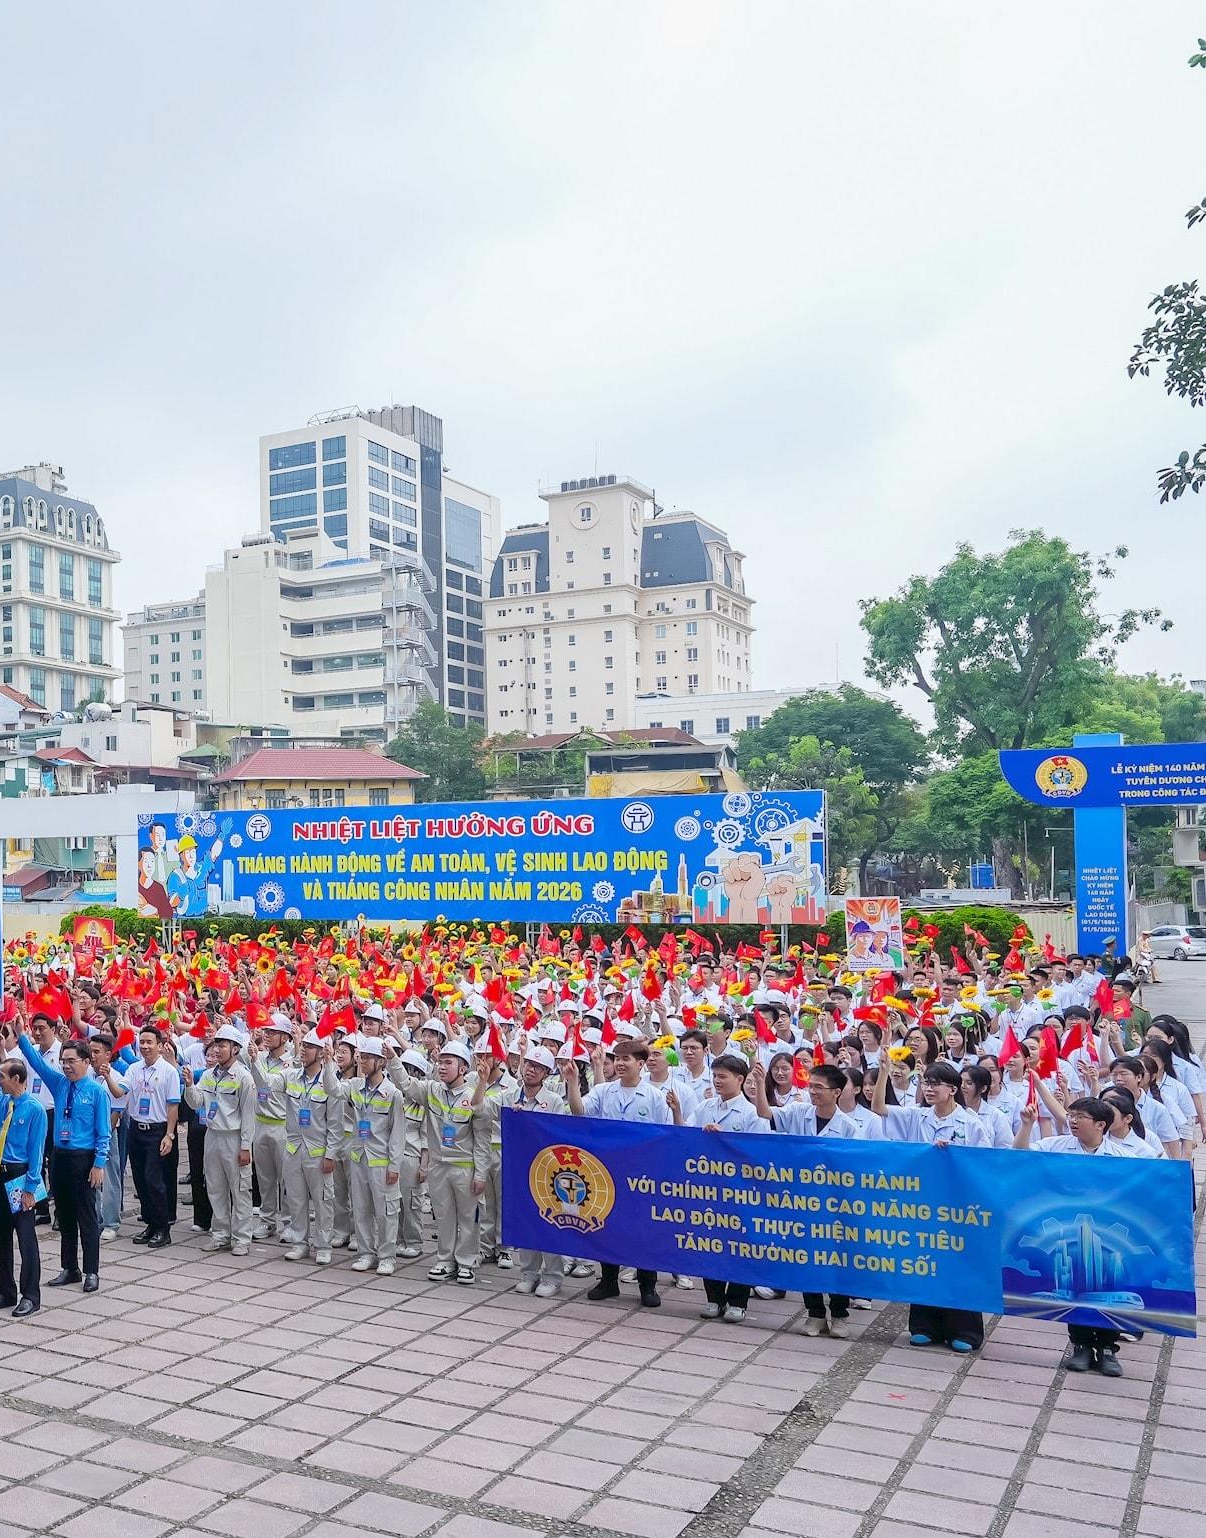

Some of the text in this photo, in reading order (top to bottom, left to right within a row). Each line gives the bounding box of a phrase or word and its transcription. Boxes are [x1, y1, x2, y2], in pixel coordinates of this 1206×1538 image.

[1111, 762, 1123, 774] LỄ
[1139, 763, 1162, 774] NIỆM
[1165, 764, 1181, 772] 140
[1183, 762, 1205, 771] NĂM
[1126, 776, 1157, 785] TUYÊN
[1158, 776, 1193, 784] DƯƠNG
[1118, 790, 1150, 798] TRONG
[1152, 788, 1178, 797] CÔNG
[1180, 787, 1198, 796] TÁC
[294, 811, 593, 843] NHIỆT LIỆT HƯỞNG ỨNG
[237, 847, 668, 877] THÁNG HÀNH ĐỘNG VỀ AN TOÀN, VỆ SINH LAO ĐỘNG
[303, 878, 582, 900] VÀ THÁNG CÔNG NHÂN NĂM 2026
[685, 1155, 920, 1192] CÔNG ĐOÀN ĐỒNG HÀNH
[626, 1174, 992, 1227] VỚI CHÍNH PHỦ NÂNG CAO NĂNG SUẤT
[651, 1205, 964, 1252] LAO ĐỘNG, THỰC HIỆN MỤC TIÊU
[674, 1232, 937, 1276] TĂNG TRƯỞNG HAI CON SỐ!
